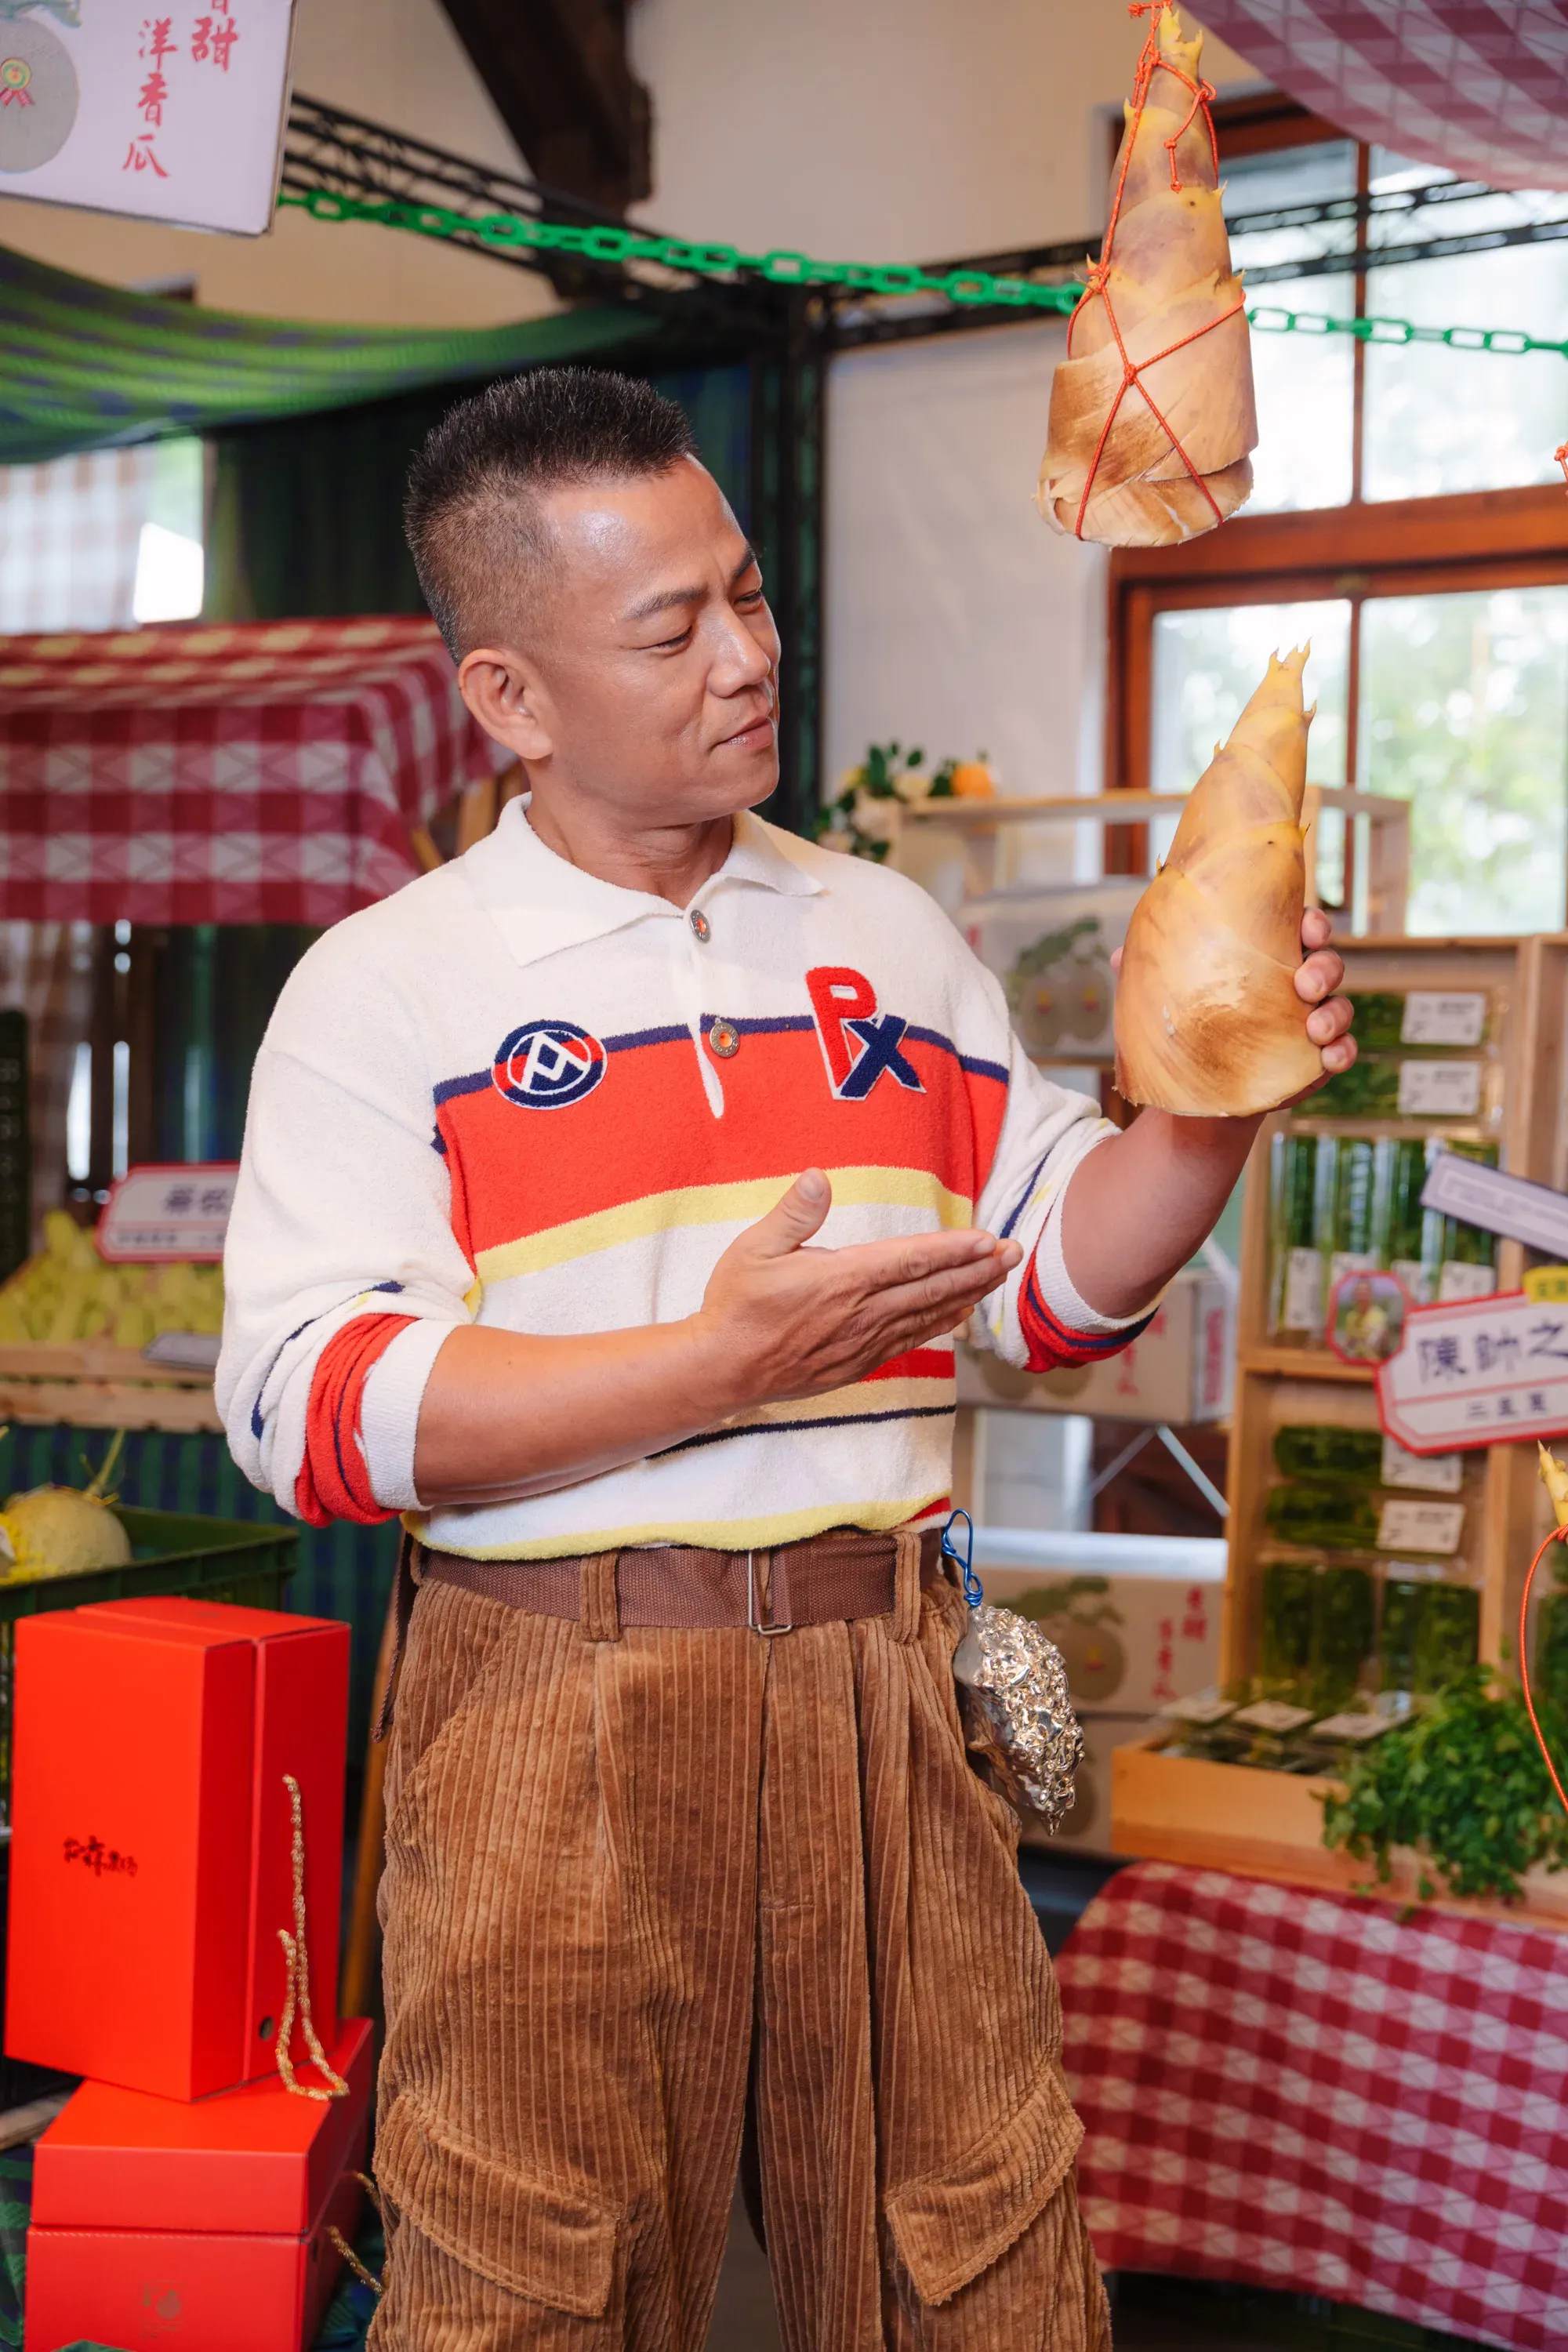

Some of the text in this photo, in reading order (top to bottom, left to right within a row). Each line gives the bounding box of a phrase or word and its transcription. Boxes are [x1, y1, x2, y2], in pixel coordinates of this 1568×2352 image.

[122, 16, 179, 179] 洋香瓜
[805, 965, 927, 1101] PX
